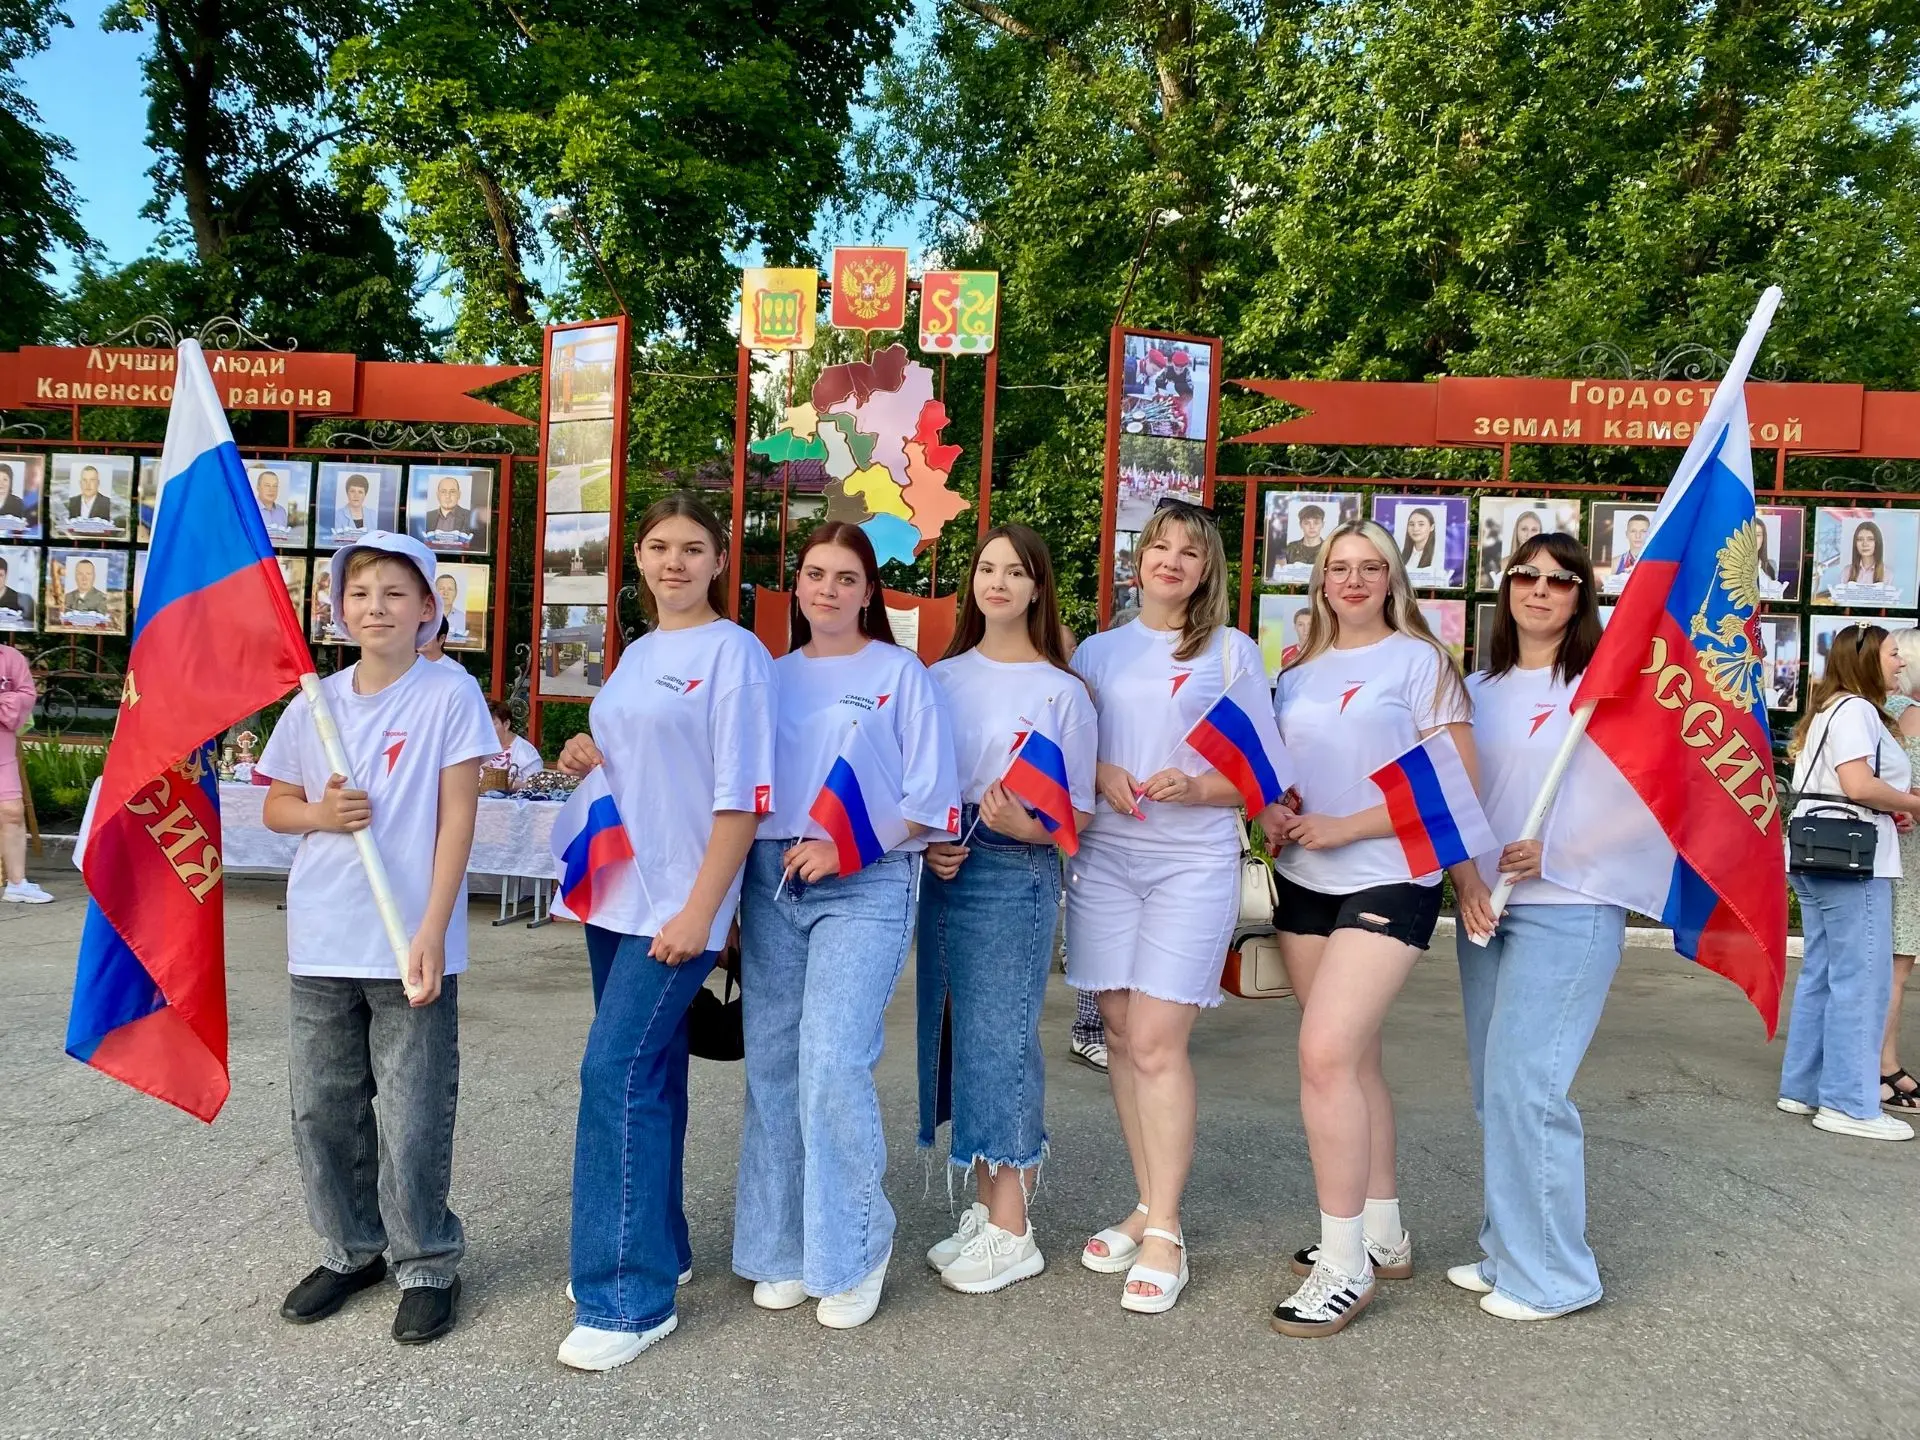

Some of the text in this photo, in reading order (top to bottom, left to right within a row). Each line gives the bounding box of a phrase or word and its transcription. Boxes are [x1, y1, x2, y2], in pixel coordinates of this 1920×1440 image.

[88, 349, 285, 375] Лучши люди
[36, 378, 332, 406] Каменско района
[1570, 381, 1717, 410] Гордост
[1473, 416, 1803, 443] земли камекой
[839, 699, 873, 711] ПЕРВЫХ
[844, 694, 875, 705] СМЕНЫ
[1640, 637, 1778, 837] ОССИЯ
[124, 775, 223, 904] СИЯ
